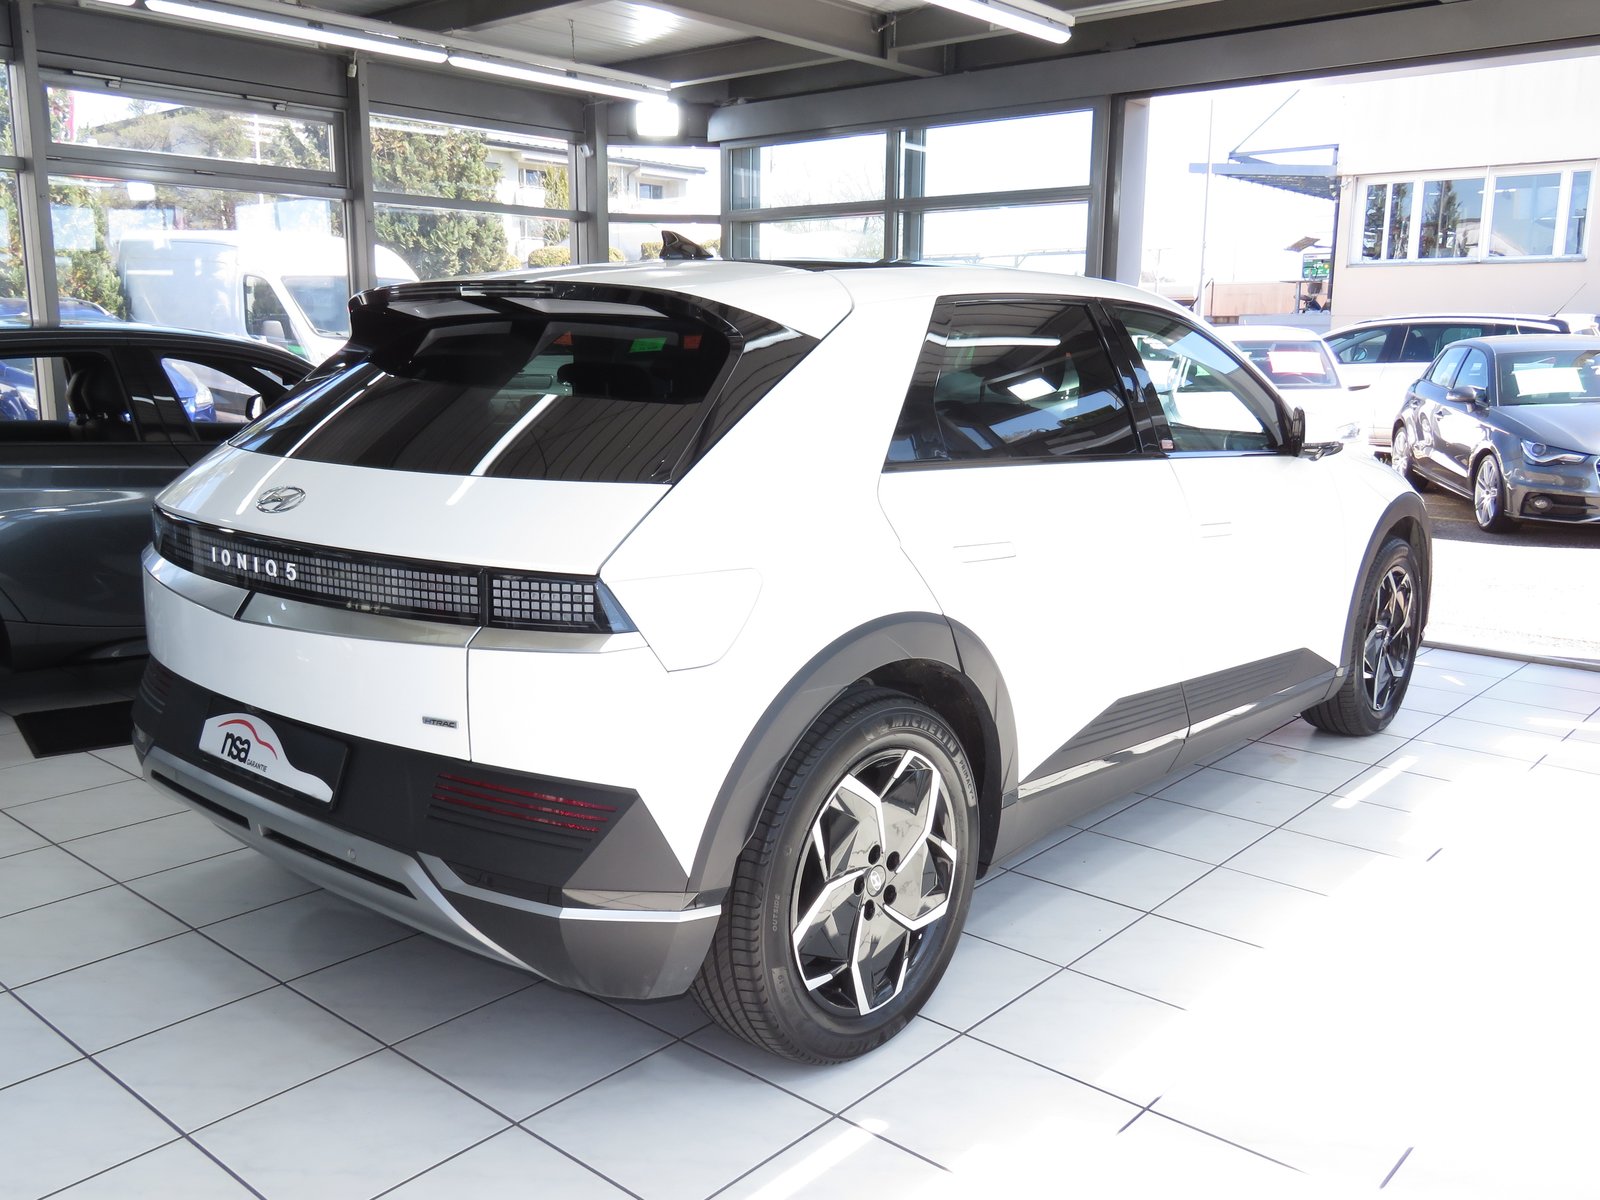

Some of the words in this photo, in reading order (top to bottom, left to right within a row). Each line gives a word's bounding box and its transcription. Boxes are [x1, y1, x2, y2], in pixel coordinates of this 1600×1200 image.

[211, 546, 277, 578] IONIQ
[286, 562, 297, 581] 5
[423, 717, 456, 729] HTRAC
[891, 714, 957, 753] MICHELIN
[220, 731, 251, 764] nsa
[246, 758, 268, 773] GARANTIE
[772, 893, 780, 932] OUTSIDE
